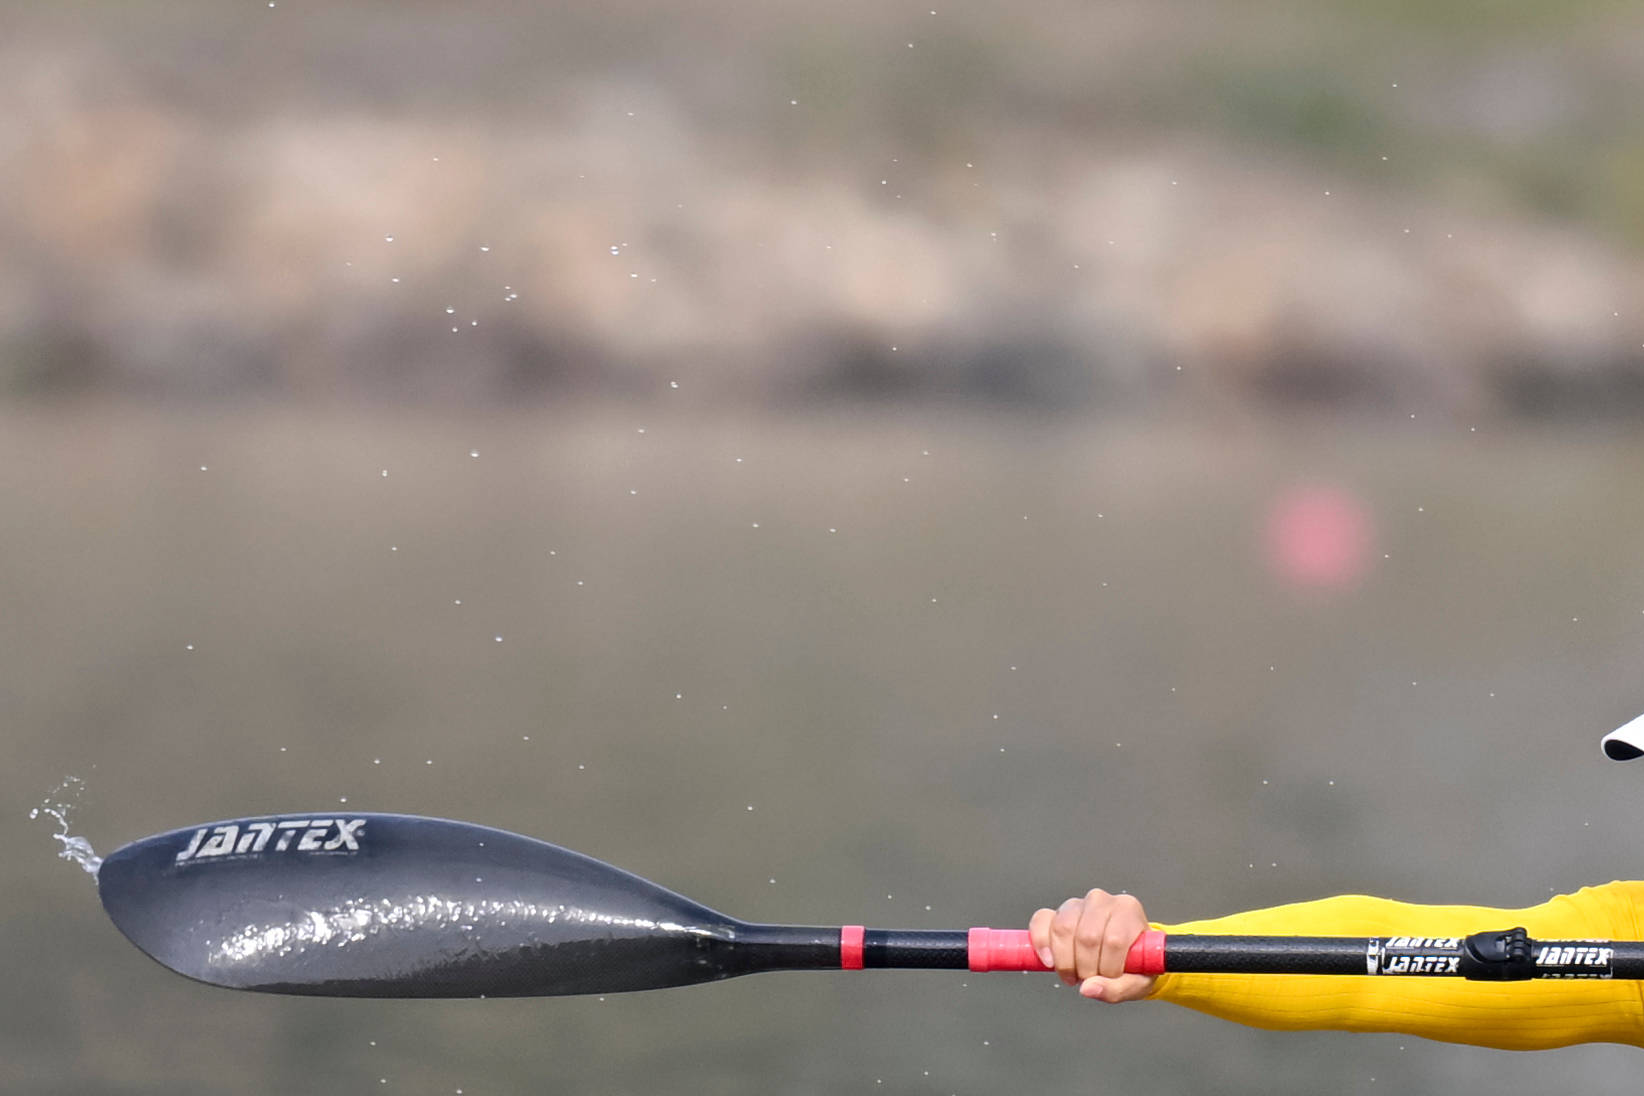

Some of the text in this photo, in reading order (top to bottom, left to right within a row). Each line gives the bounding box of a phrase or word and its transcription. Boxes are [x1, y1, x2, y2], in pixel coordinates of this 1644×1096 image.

[176, 818, 367, 861] JANTEX
[1388, 956, 1460, 973] JANTEX
[1536, 947, 1610, 965] JANTEX
